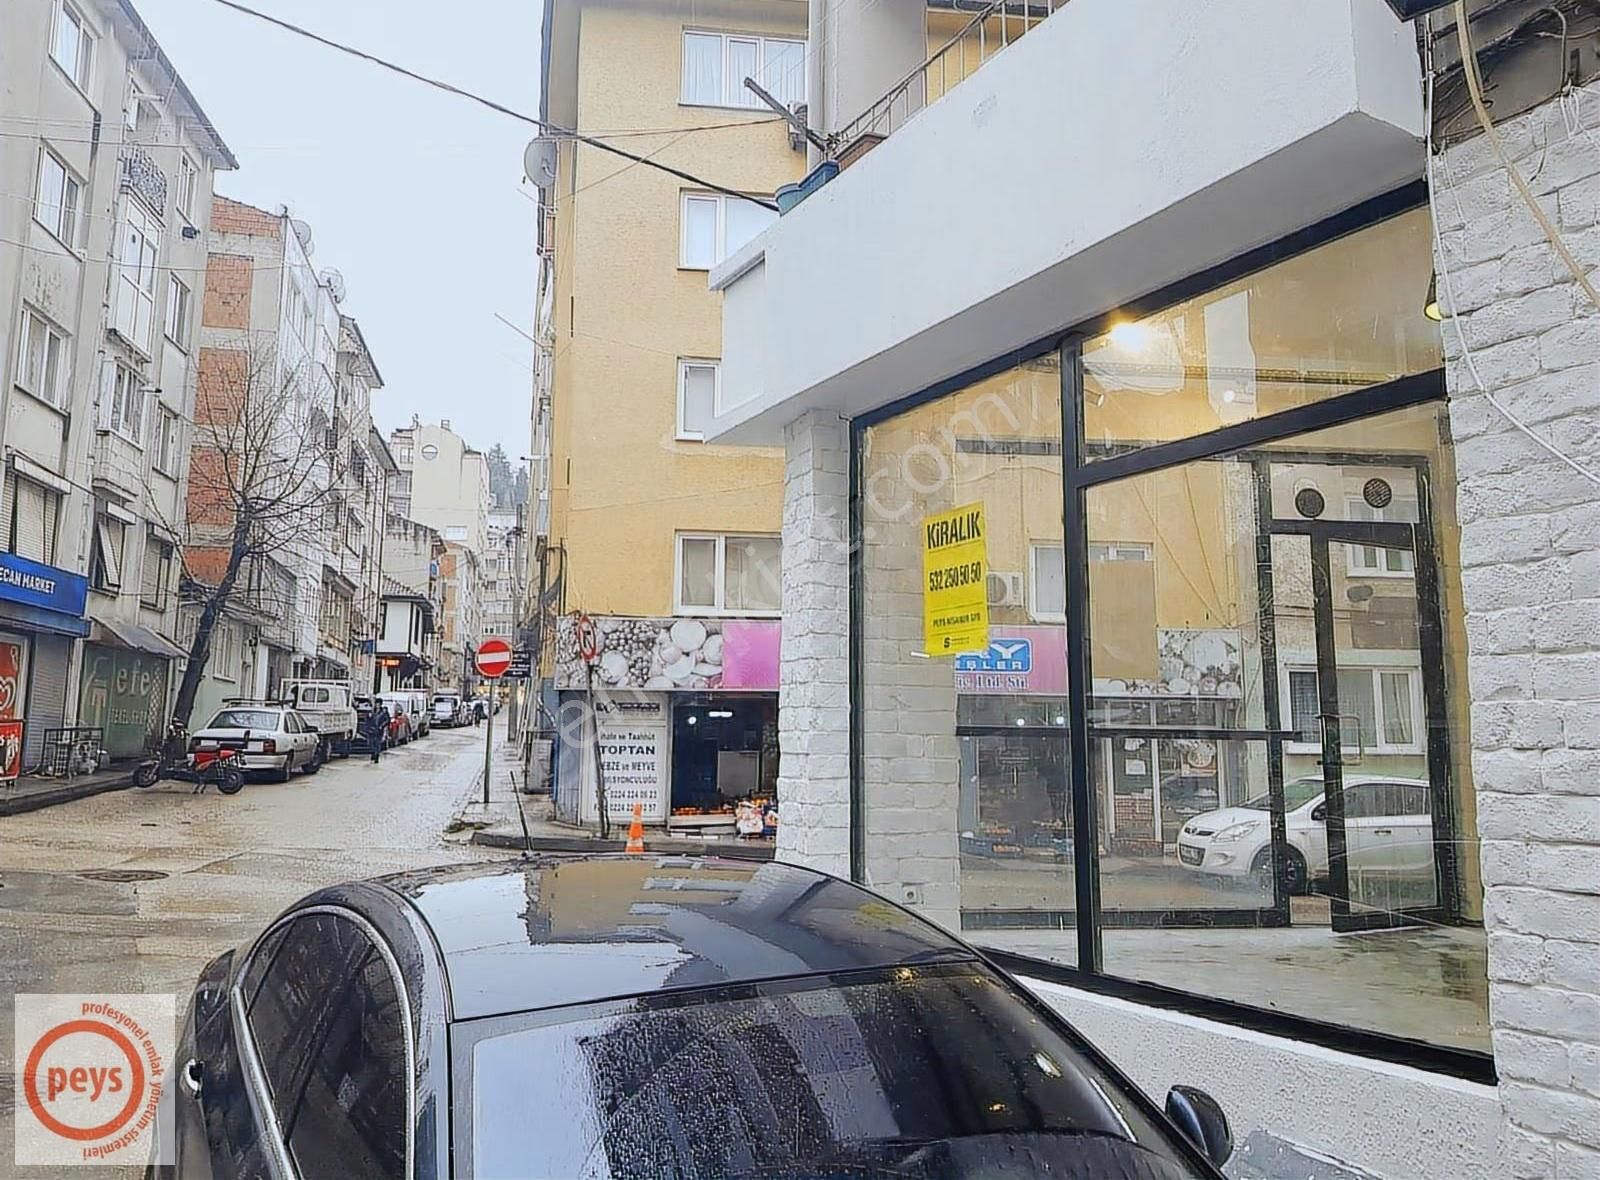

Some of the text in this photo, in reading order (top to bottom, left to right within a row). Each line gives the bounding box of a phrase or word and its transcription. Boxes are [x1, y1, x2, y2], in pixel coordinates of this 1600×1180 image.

[22, 574, 55, 594] MARKET
[929, 569, 943, 591] 532
[600, 745, 655, 755] TOPTAN
[602, 761, 620, 771] EBZE
